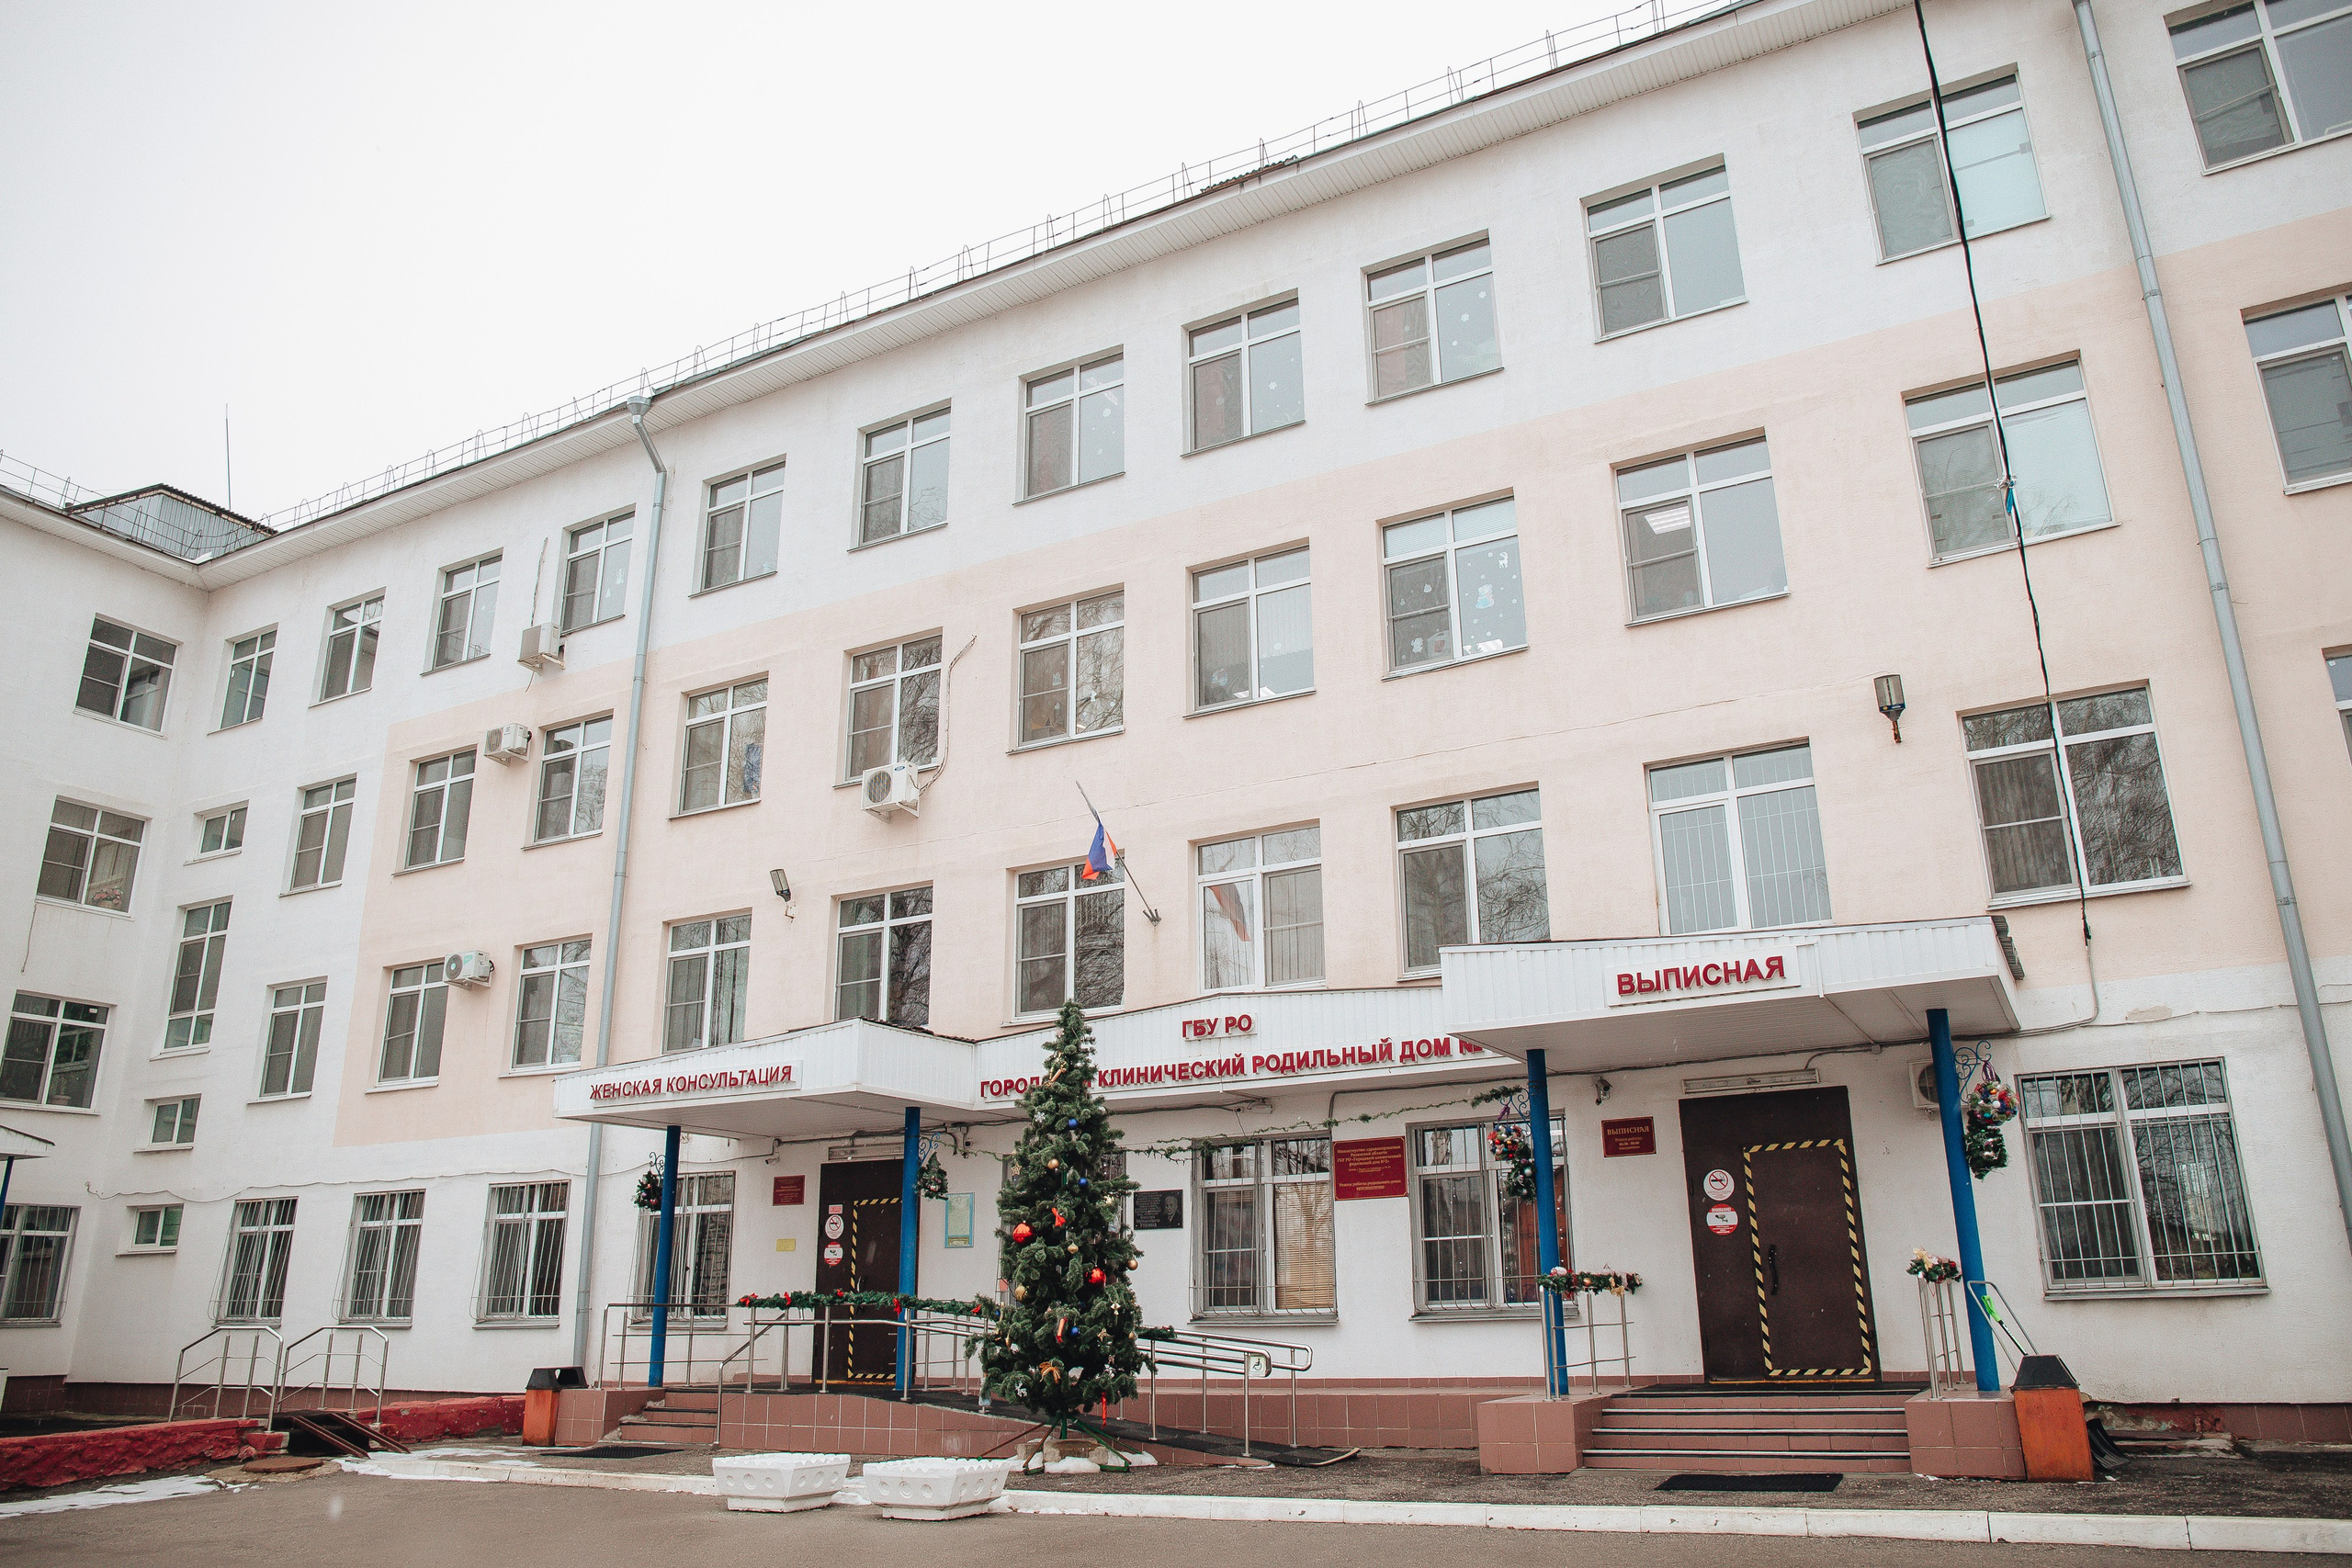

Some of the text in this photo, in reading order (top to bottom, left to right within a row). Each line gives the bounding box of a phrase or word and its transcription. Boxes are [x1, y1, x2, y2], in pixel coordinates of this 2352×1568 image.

[1617, 956, 1785, 996] ВЫПИСНАЯ
[1182, 1014, 1252, 1038] ГБУ РО
[1098, 1054, 1245, 1087] КЛИНИЧЕСКИЙ
[1252, 1038, 1393, 1074] РОДИЛЬНЫЙ
[1399, 1037, 1452, 1063] ДОМ
[590, 1066, 792, 1100] ЖЕНСКАЯ КОНСУЛЬТАЦИЯ
[1607, 1126, 1650, 1135] ВЫПИСНАЯ
